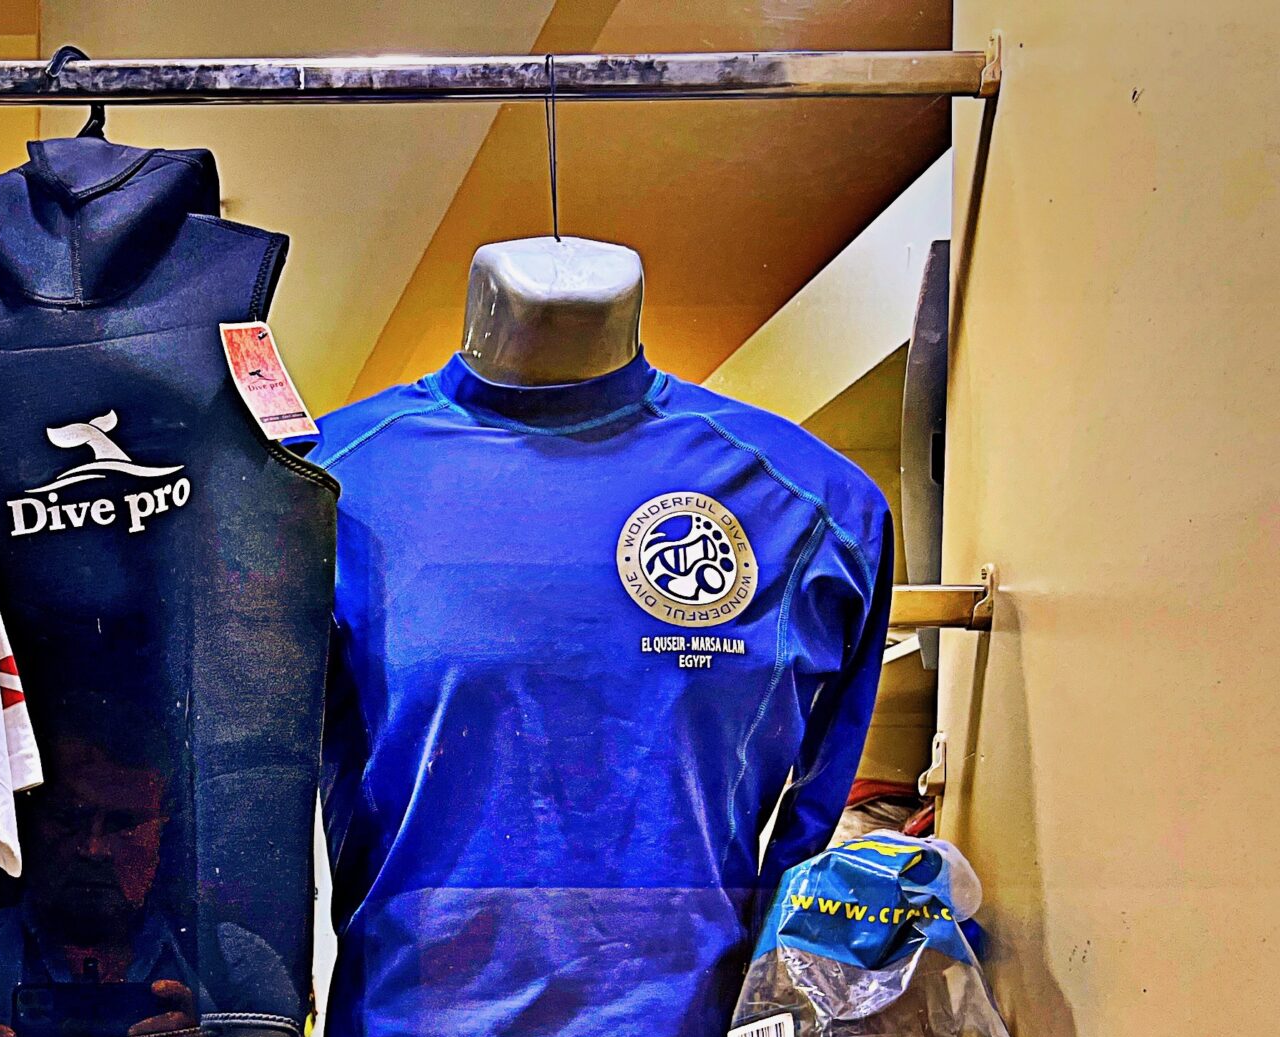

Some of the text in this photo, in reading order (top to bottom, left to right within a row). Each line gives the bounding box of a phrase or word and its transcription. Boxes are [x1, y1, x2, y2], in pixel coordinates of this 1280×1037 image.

[6, 477, 191, 537] Dive pro
[624, 496, 748, 552] WONDERFUL DIVE
[625, 572, 752, 621] WONDERFUL DIVE
[641, 637, 652, 652] EL
[653, 636, 686, 653] QUSEIR
[691, 637, 722, 652] MARSA
[723, 638, 745, 654] ALAM
[679, 654, 712, 669] EGYPT
